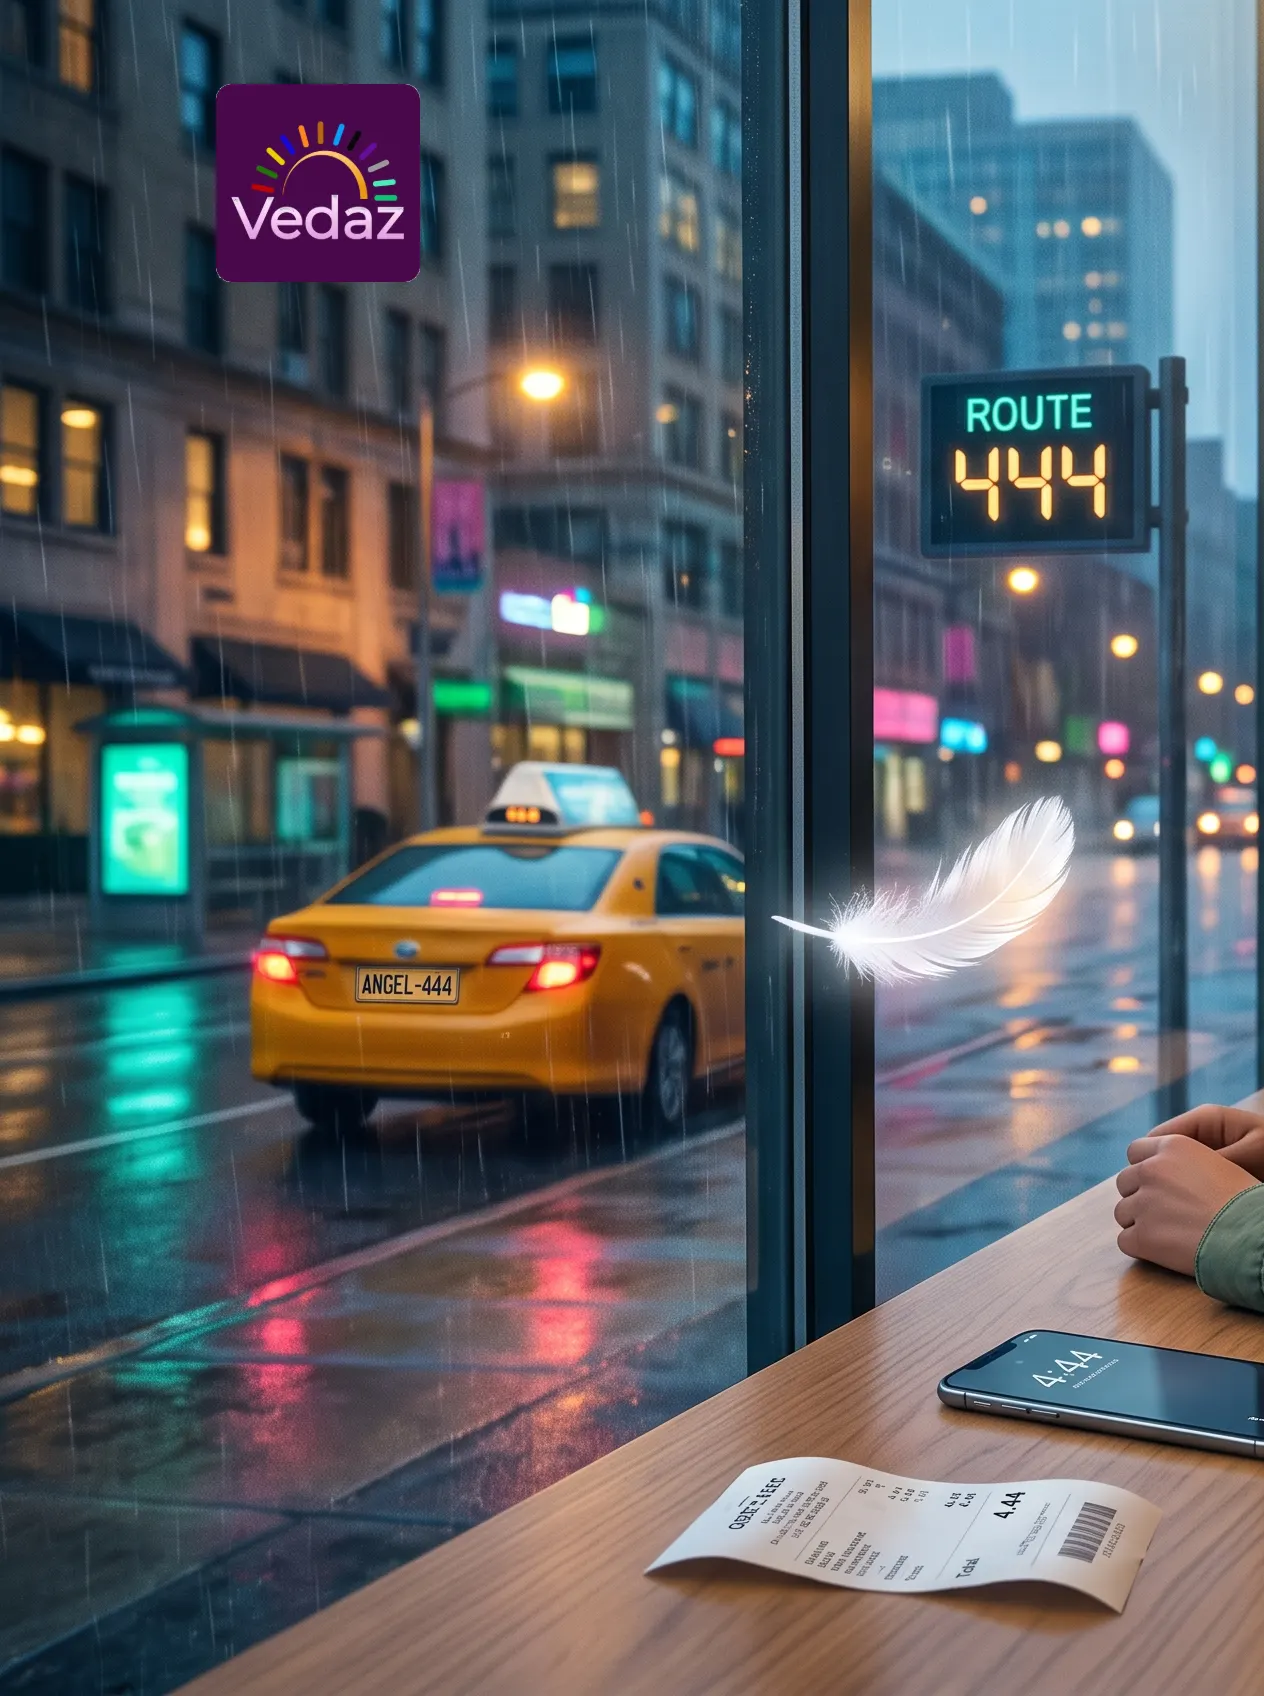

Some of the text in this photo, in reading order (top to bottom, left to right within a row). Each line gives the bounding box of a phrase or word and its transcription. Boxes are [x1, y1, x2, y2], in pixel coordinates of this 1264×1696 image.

[967, 393, 1092, 432] ROUTE
[955, 443, 1106, 522] 444
[361, 974, 452, 996] ANGEL-444
[1032, 1350, 1103, 1387] 4:44
[993, 1491, 1026, 1519] 4.44
